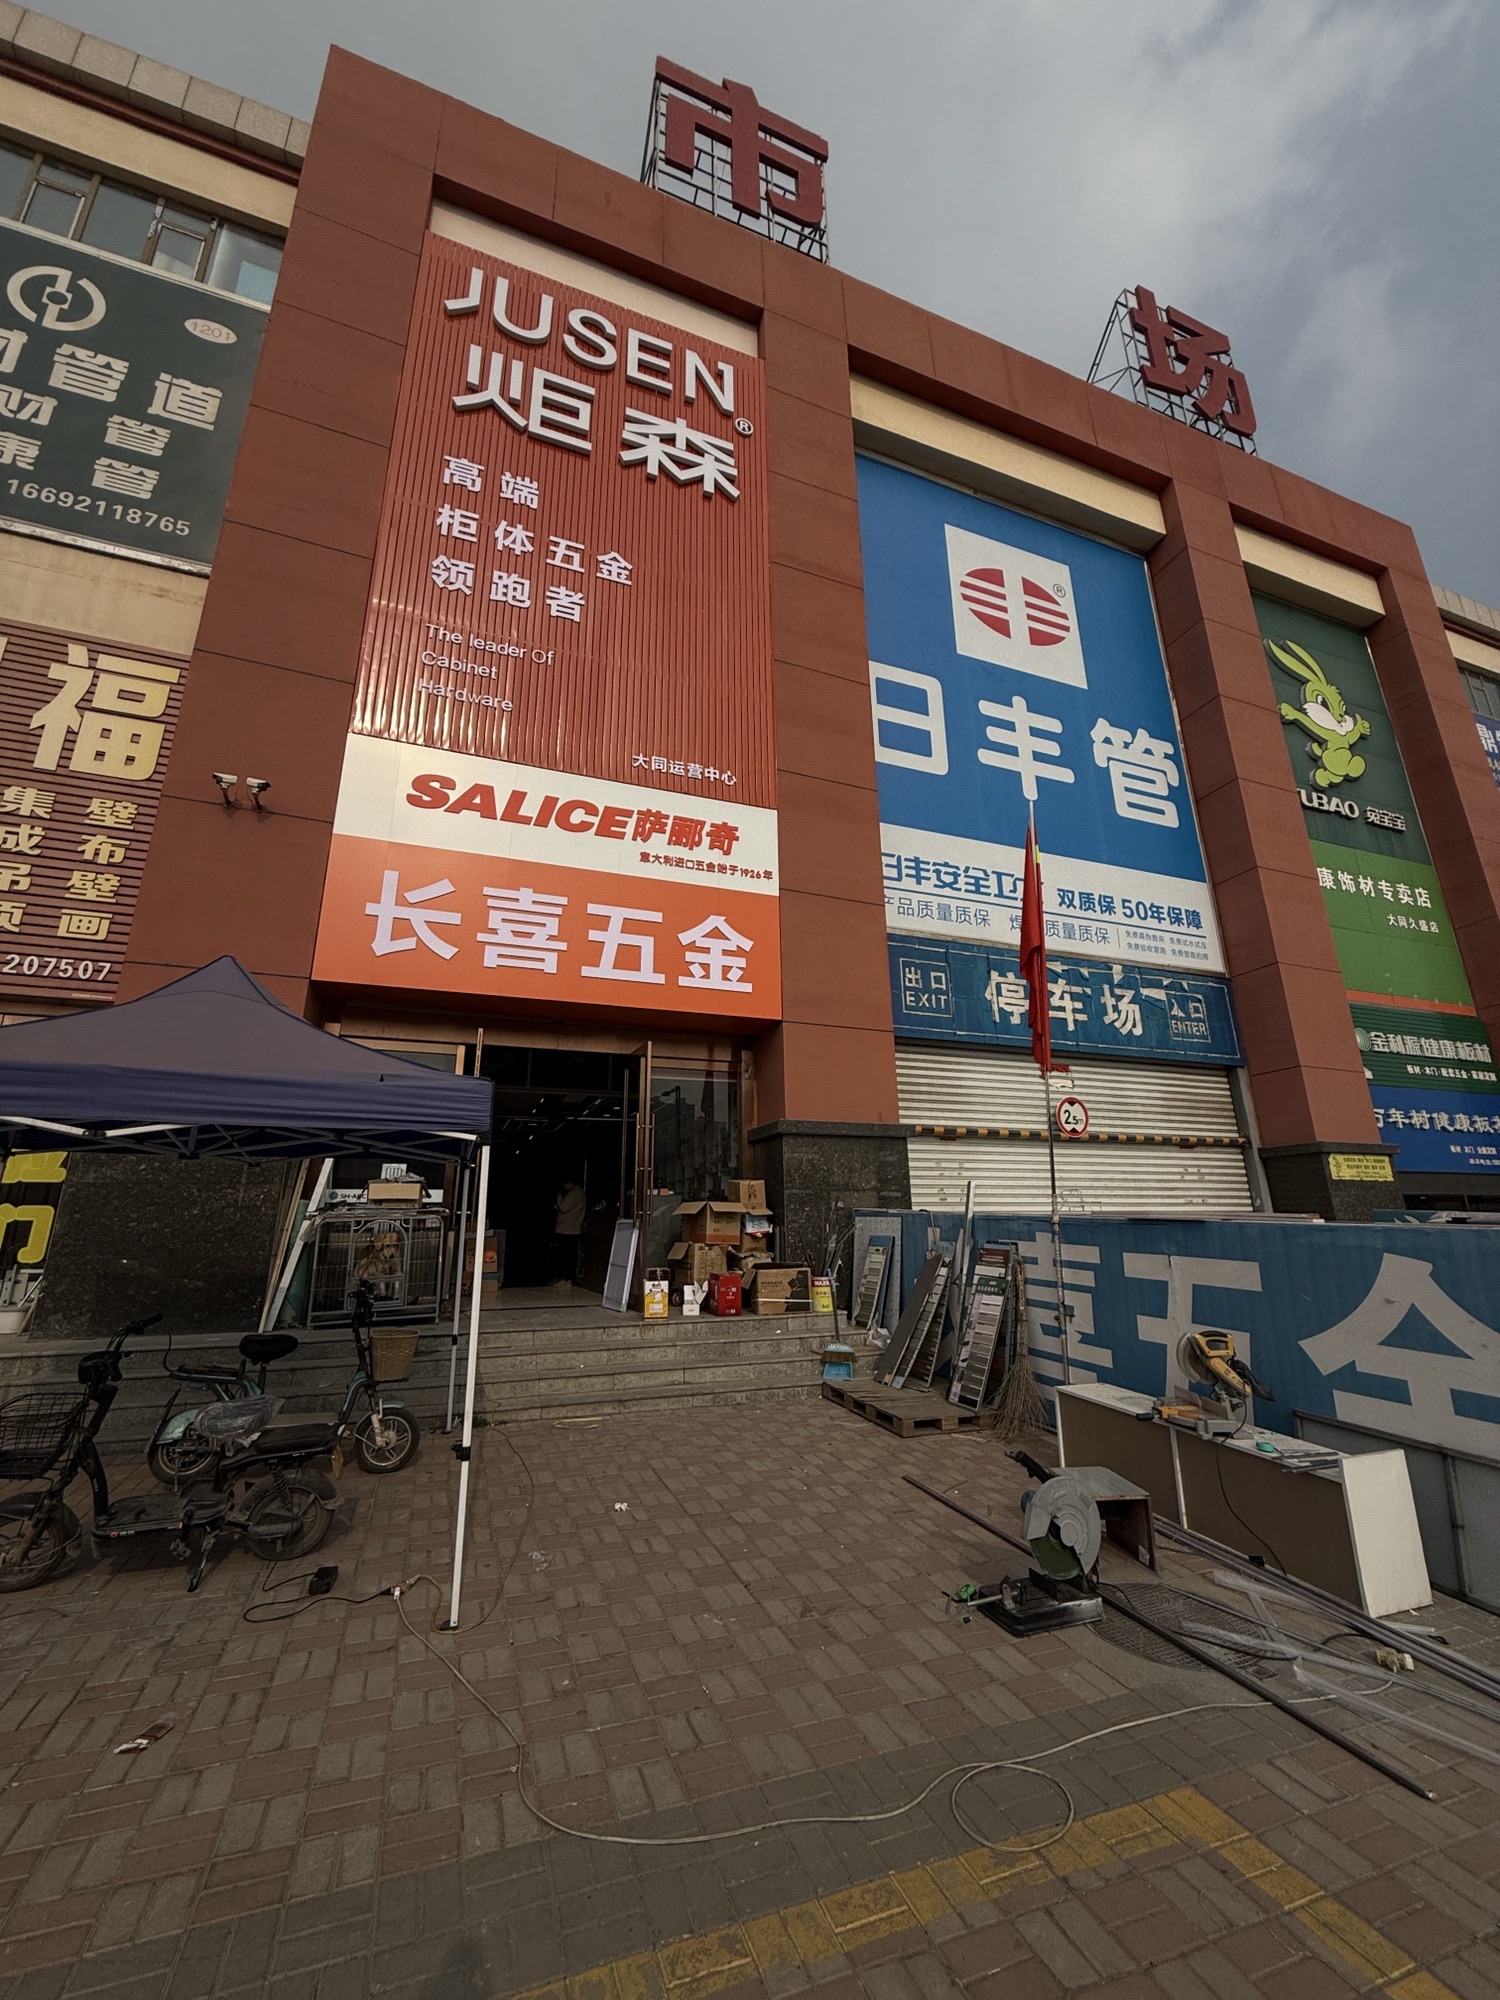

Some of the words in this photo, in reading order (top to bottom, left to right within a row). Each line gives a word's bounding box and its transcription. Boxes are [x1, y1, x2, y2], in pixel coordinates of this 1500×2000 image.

[656, 55, 828, 227] 市
[1130, 284, 1257, 436] 场
[191, 321, 232, 342] 1201
[444, 267, 735, 416] JUSEN
[106, 415, 171, 457] 管
[92, 457, 160, 500] 管
[443, 455, 540, 510] 高端
[7, 479, 191, 536] 16692118765
[436, 503, 634, 586] 柜体五金
[431, 554, 586, 622] 领跑者
[421, 651, 497, 679] Cabinet
[425, 624, 463, 644] The
[469, 634, 527, 658] leader
[531, 649, 554, 665] Of
[0, 637, 181, 781] 福
[417, 678, 513, 712] Hardware
[869, 660, 1180, 828] 日丰管
[632, 753, 737, 786] 大同运营中心
[1365, 806, 1407, 831] 兔宝宝
[57, 798, 139, 941] 壁布壁画
[639, 851, 774, 882] 意大利进口五金始于1926年
[881, 852, 1044, 903] 日丰安全卫
[1057, 888, 1117, 917] 双质保
[1121, 898, 1203, 931] 50年保障
[1316, 867, 1432, 908] 康饰材专卖店
[364, 870, 754, 993] 长喜五金
[1387, 914, 1439, 934] 大同久盛店
[2, 954, 112, 981] 207507
[905, 967, 946, 991] 出口
[906, 991, 948, 1010] EXIT
[984, 970, 1144, 1036] 停车场
[1170, 998, 1204, 1019] 入口
[1171, 1020, 1208, 1036] ENTER
